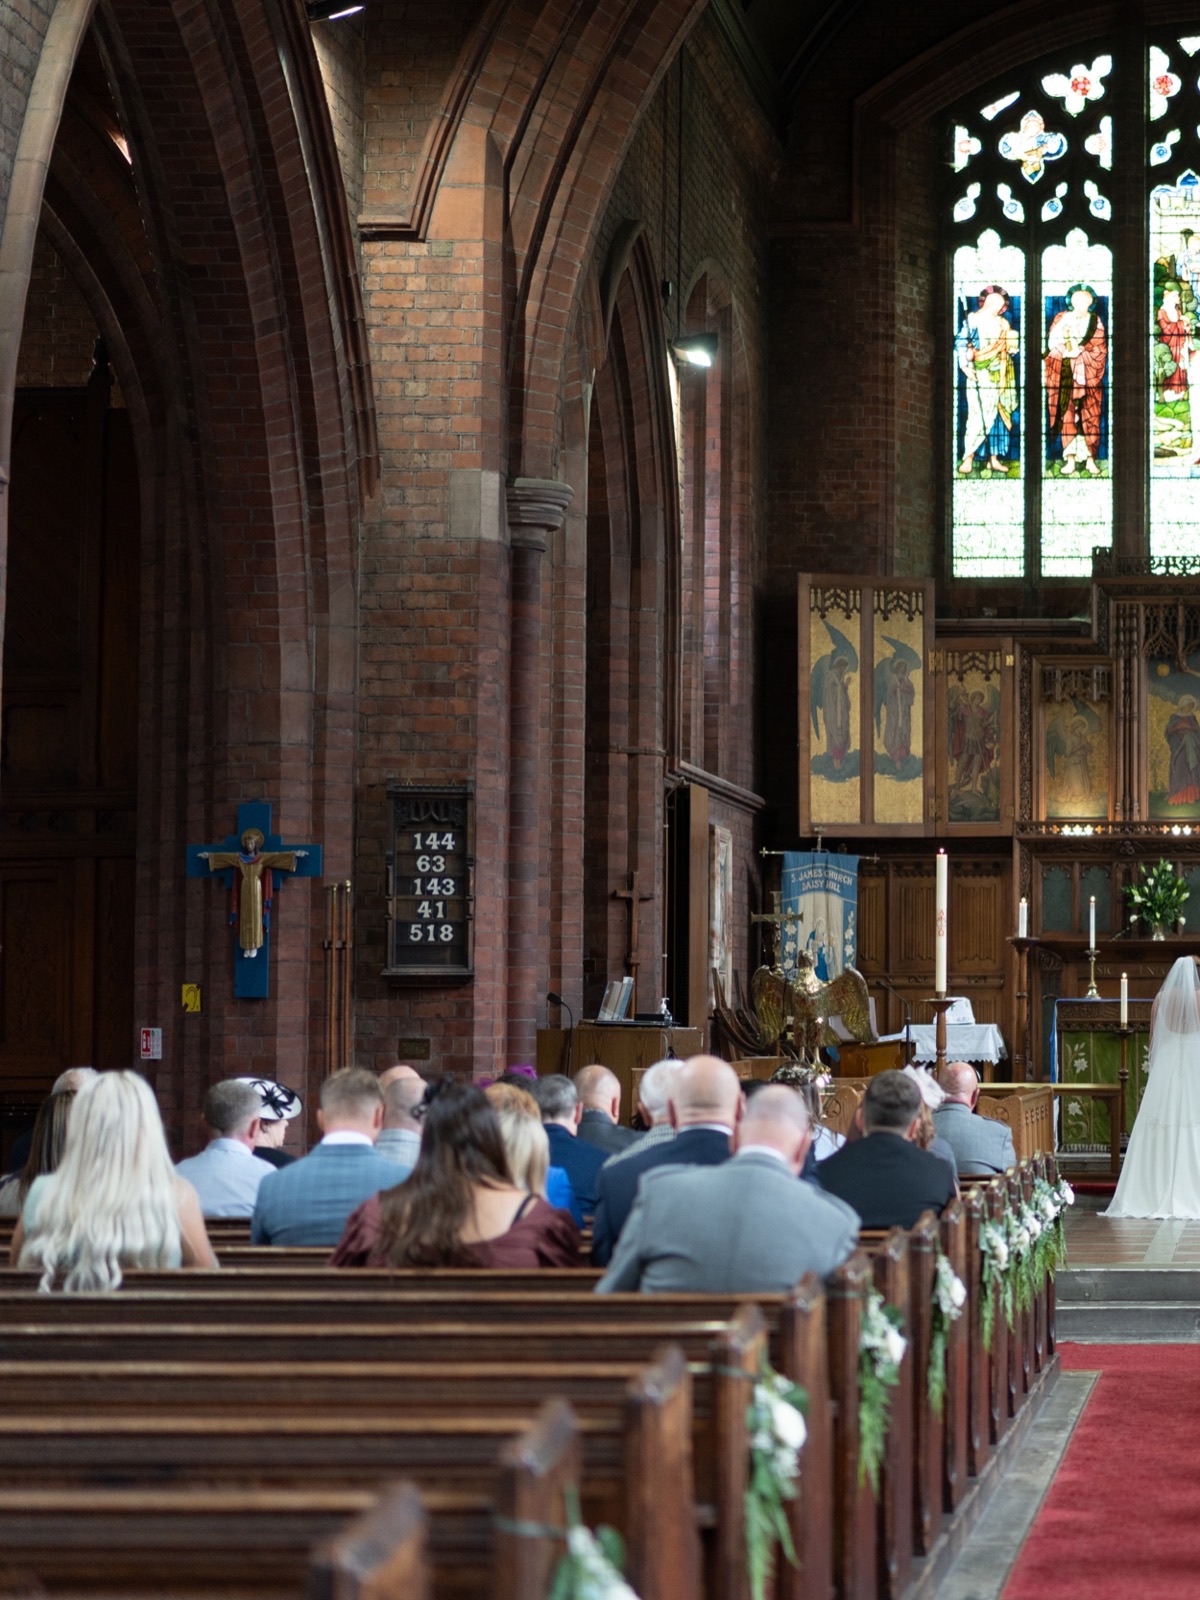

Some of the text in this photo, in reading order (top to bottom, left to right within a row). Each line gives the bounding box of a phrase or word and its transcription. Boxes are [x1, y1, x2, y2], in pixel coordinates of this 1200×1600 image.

[414, 833, 455, 850] 144
[416, 855, 446, 873] 63
[799, 868, 823, 882] JAMES
[823, 869, 853, 886] CHURCH
[414, 878, 455, 895] 143
[801, 879, 841, 893] DAISY HILL
[417, 901, 444, 918] 41
[409, 924, 453, 941] 518
